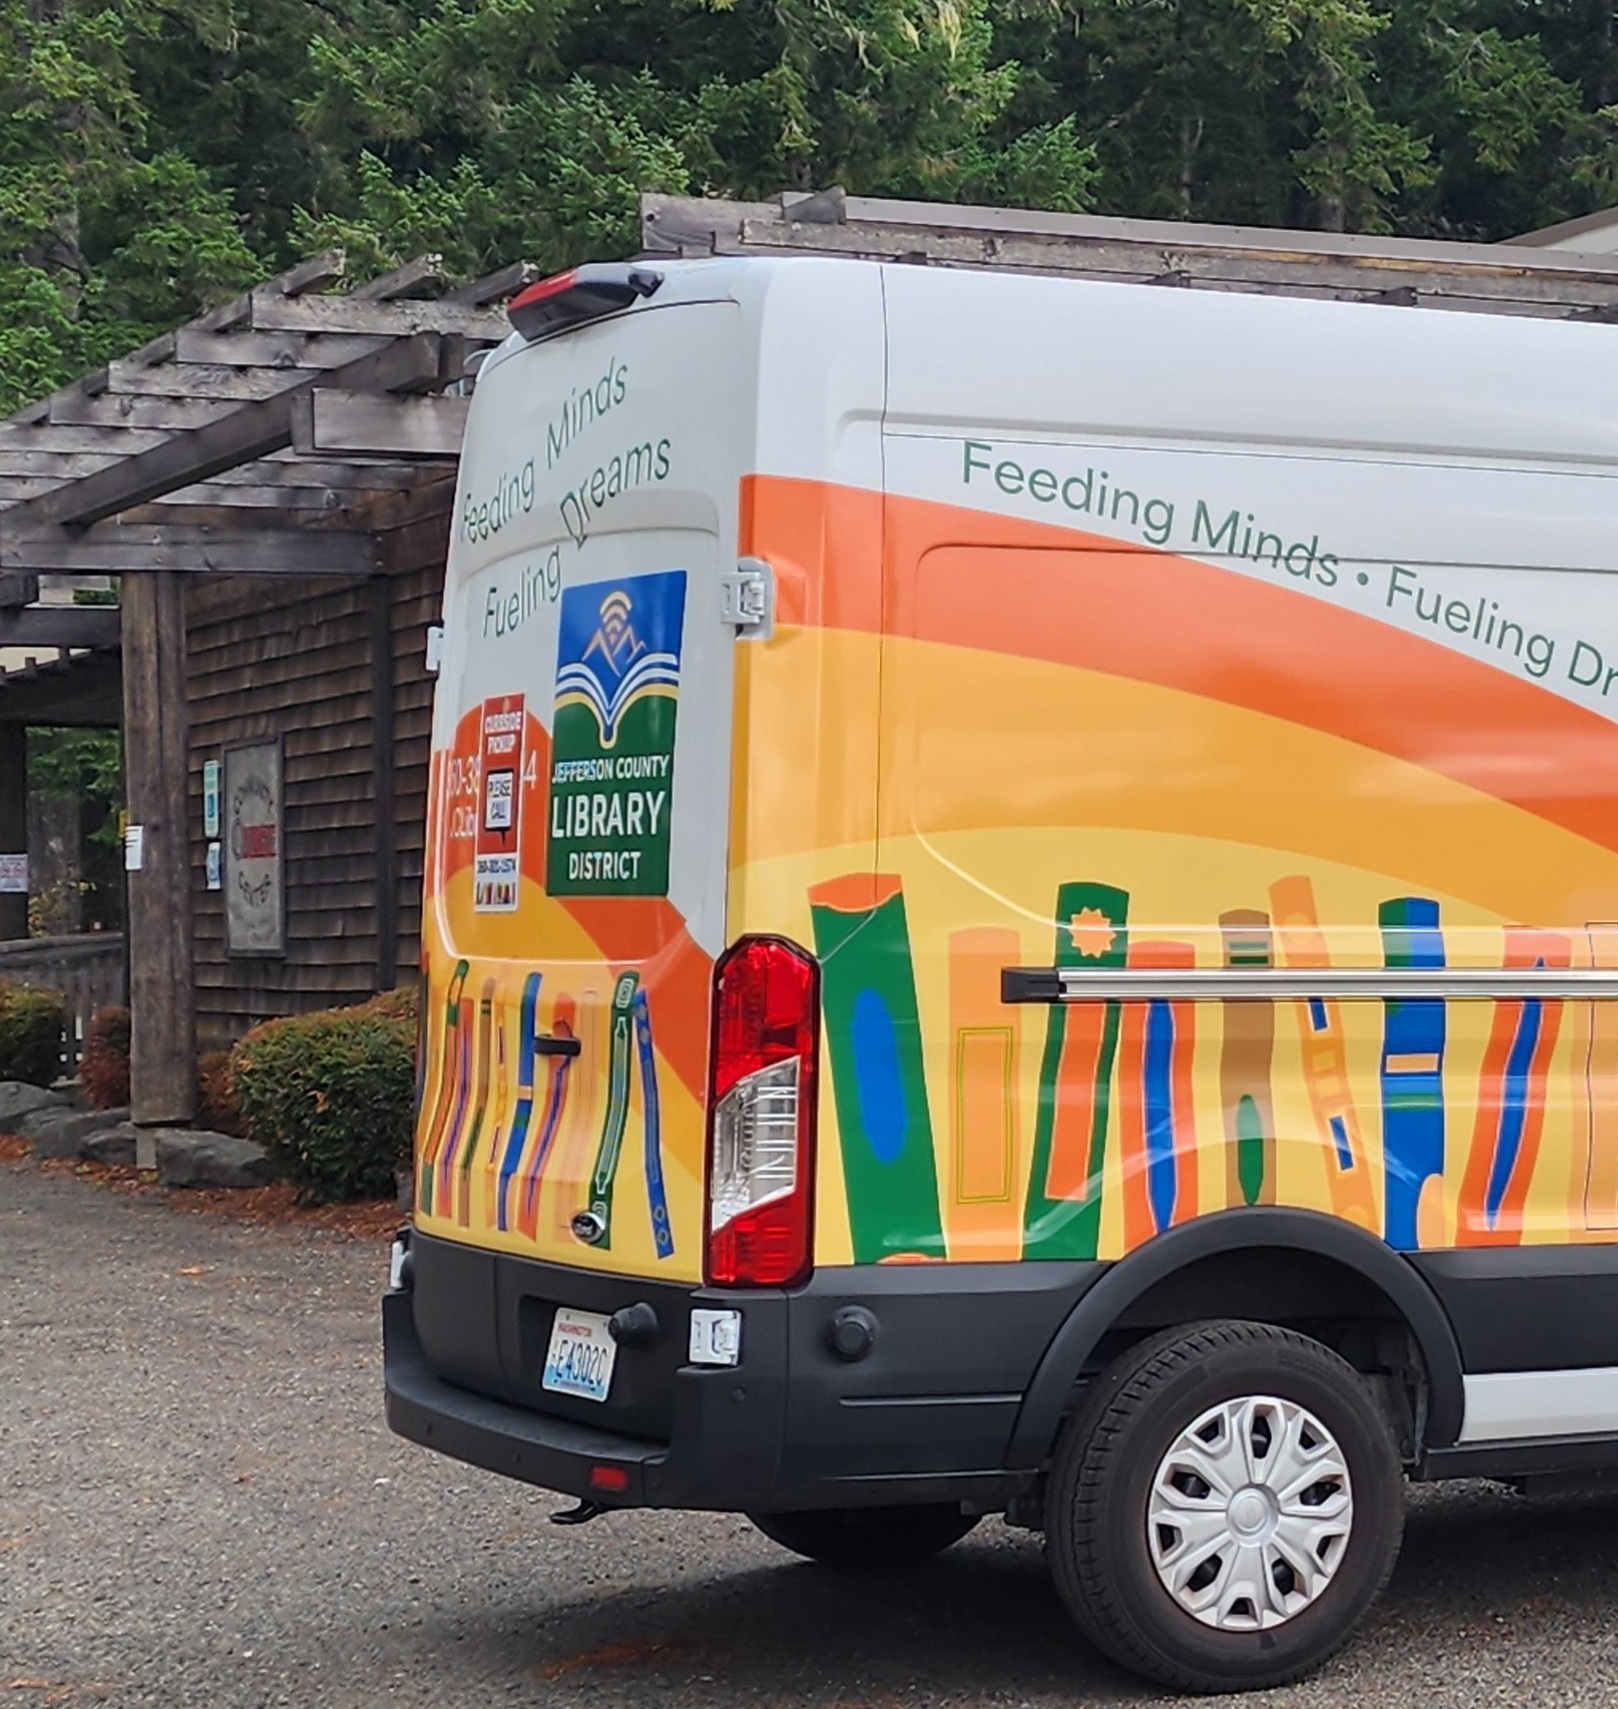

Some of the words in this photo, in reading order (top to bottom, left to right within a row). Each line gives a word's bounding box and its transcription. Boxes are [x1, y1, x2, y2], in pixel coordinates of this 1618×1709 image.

[461, 457, 535, 544] Feeding
[546, 356, 628, 470] Minds
[483, 545, 562, 639] Fueling
[560, 438, 671, 550] Dreams
[962, 439, 1175, 544] Feeding
[1191, 499, 1340, 587] Minds
[1385, 565, 1557, 678] Fueling
[552, 761, 613, 784] JEFFERSON
[615, 754, 670, 779] COUNTY
[552, 790, 666, 839] LIBRARY
[569, 852, 642, 880] DISTRICT
